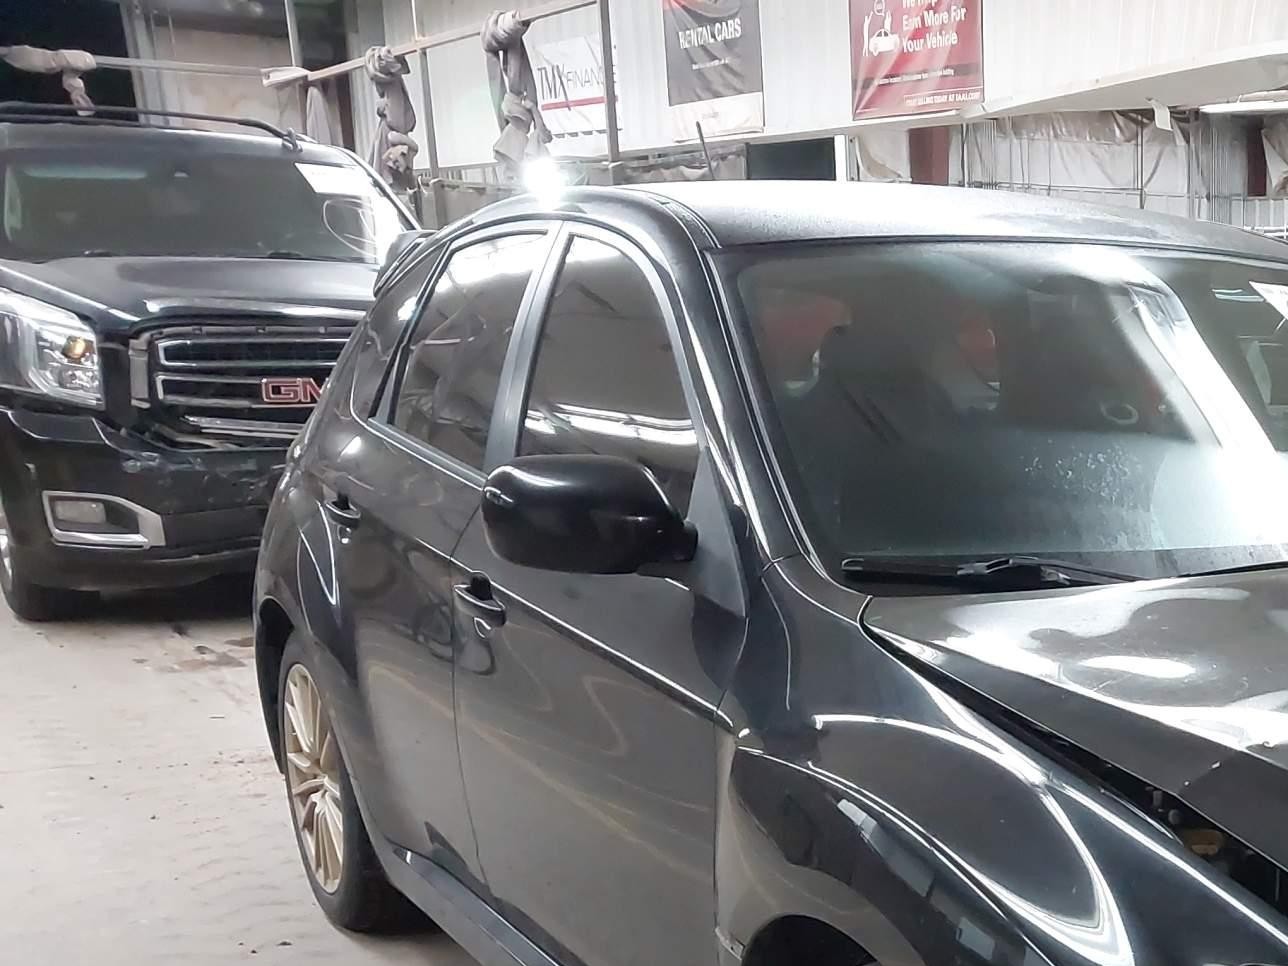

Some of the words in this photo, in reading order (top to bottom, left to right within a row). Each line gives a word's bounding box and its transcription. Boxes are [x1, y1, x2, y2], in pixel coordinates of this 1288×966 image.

[923, 9, 949, 28] More
[951, 5, 966, 23] For
[678, 25, 715, 48] RENTAL
[714, 18, 742, 42] CARS
[902, 37, 924, 53] Your
[926, 30, 958, 49] Vehicle
[261, 377, 325, 402] GM
